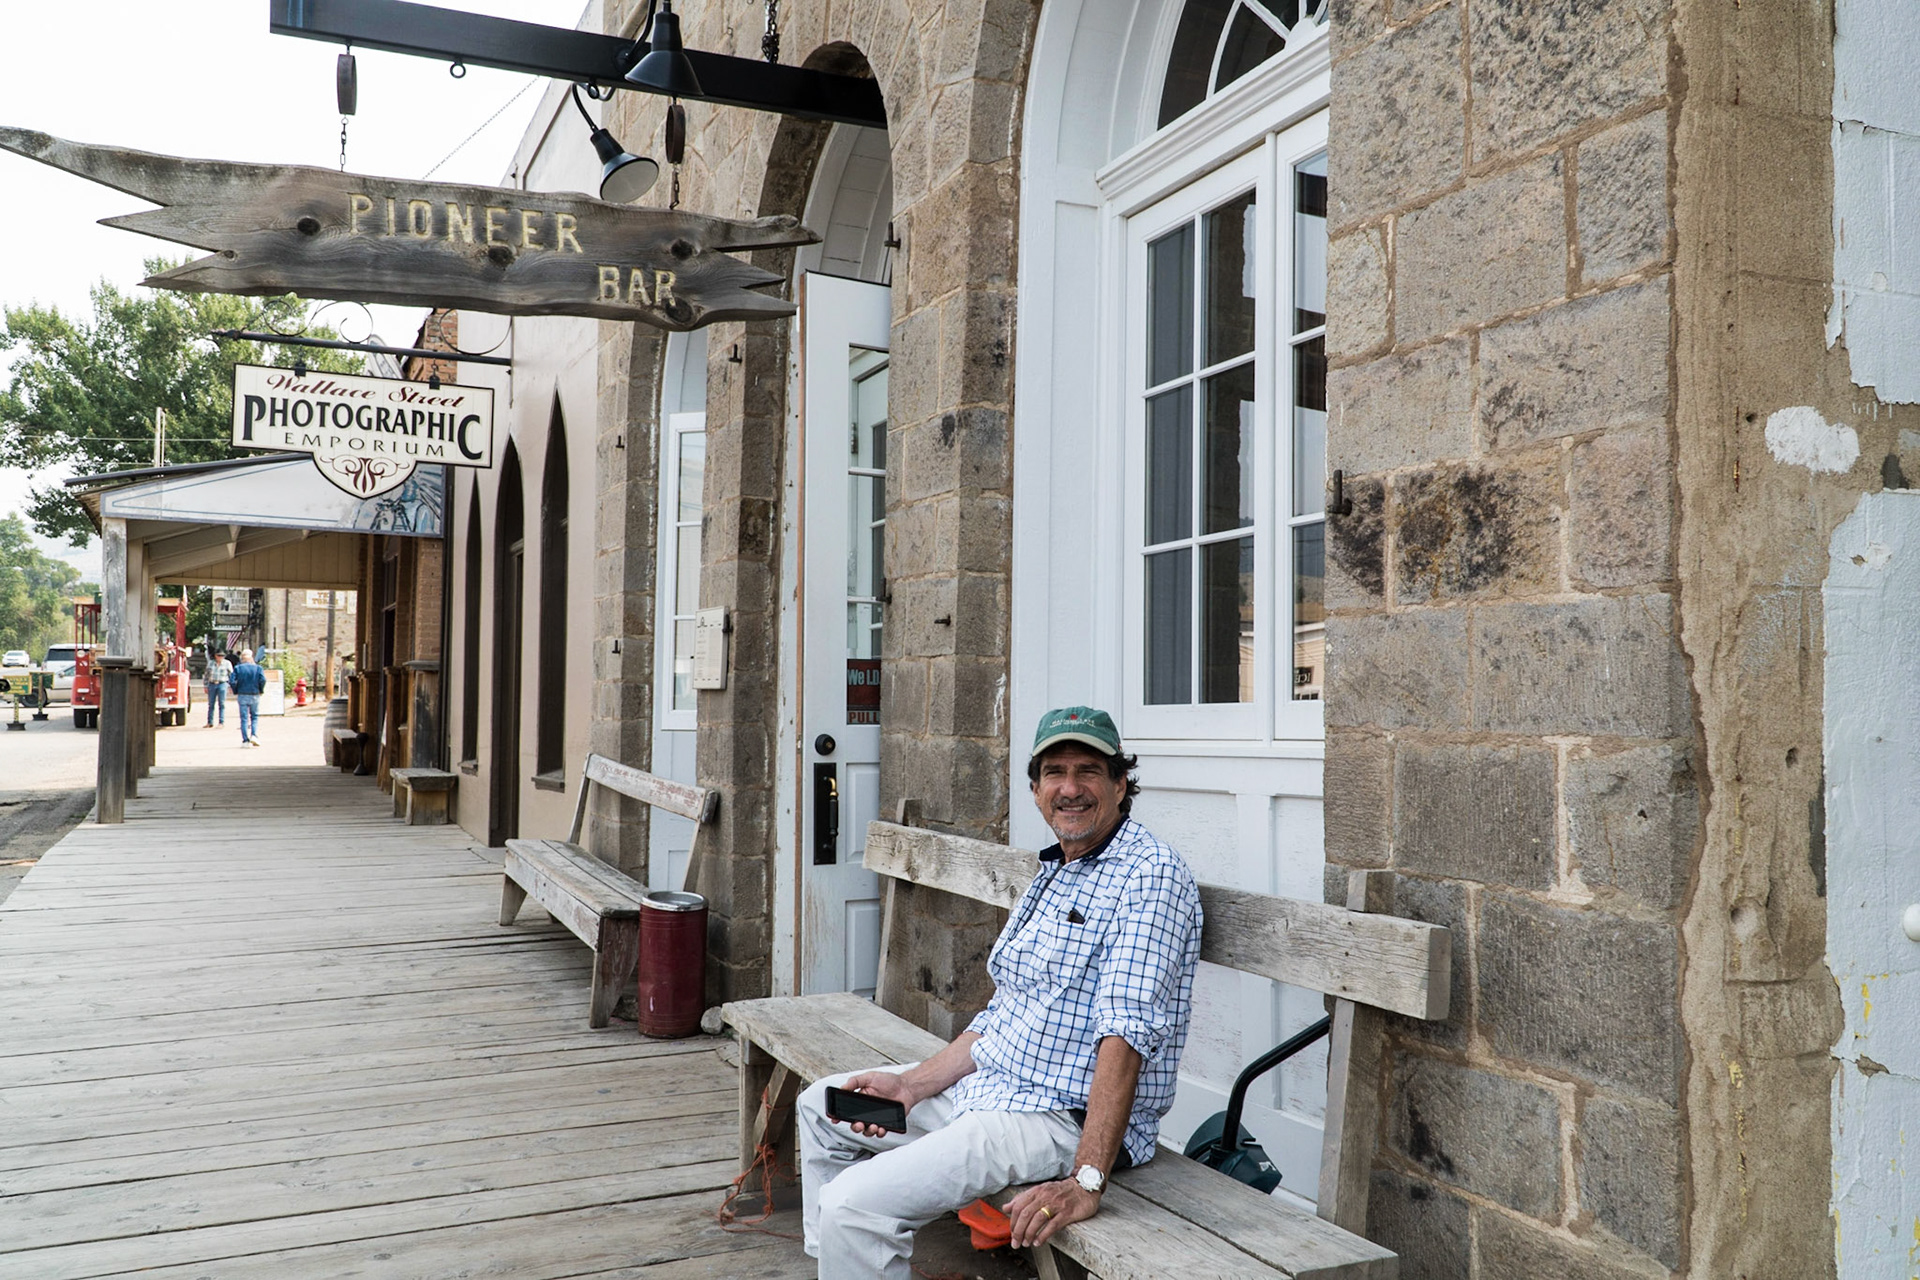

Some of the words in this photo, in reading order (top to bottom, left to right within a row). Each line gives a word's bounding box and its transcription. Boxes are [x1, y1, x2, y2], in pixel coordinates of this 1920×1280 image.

[350, 193, 583, 253] PIONEER
[597, 265, 677, 307] BAR
[267, 374, 376, 399] Wallace
[388, 386, 465, 408] Street
[242, 395, 483, 460] PHOTOGRAPHIC
[285, 432, 444, 457] EMPORIUM
[847, 669, 864, 685] We
[849, 712, 878, 723] PULL
